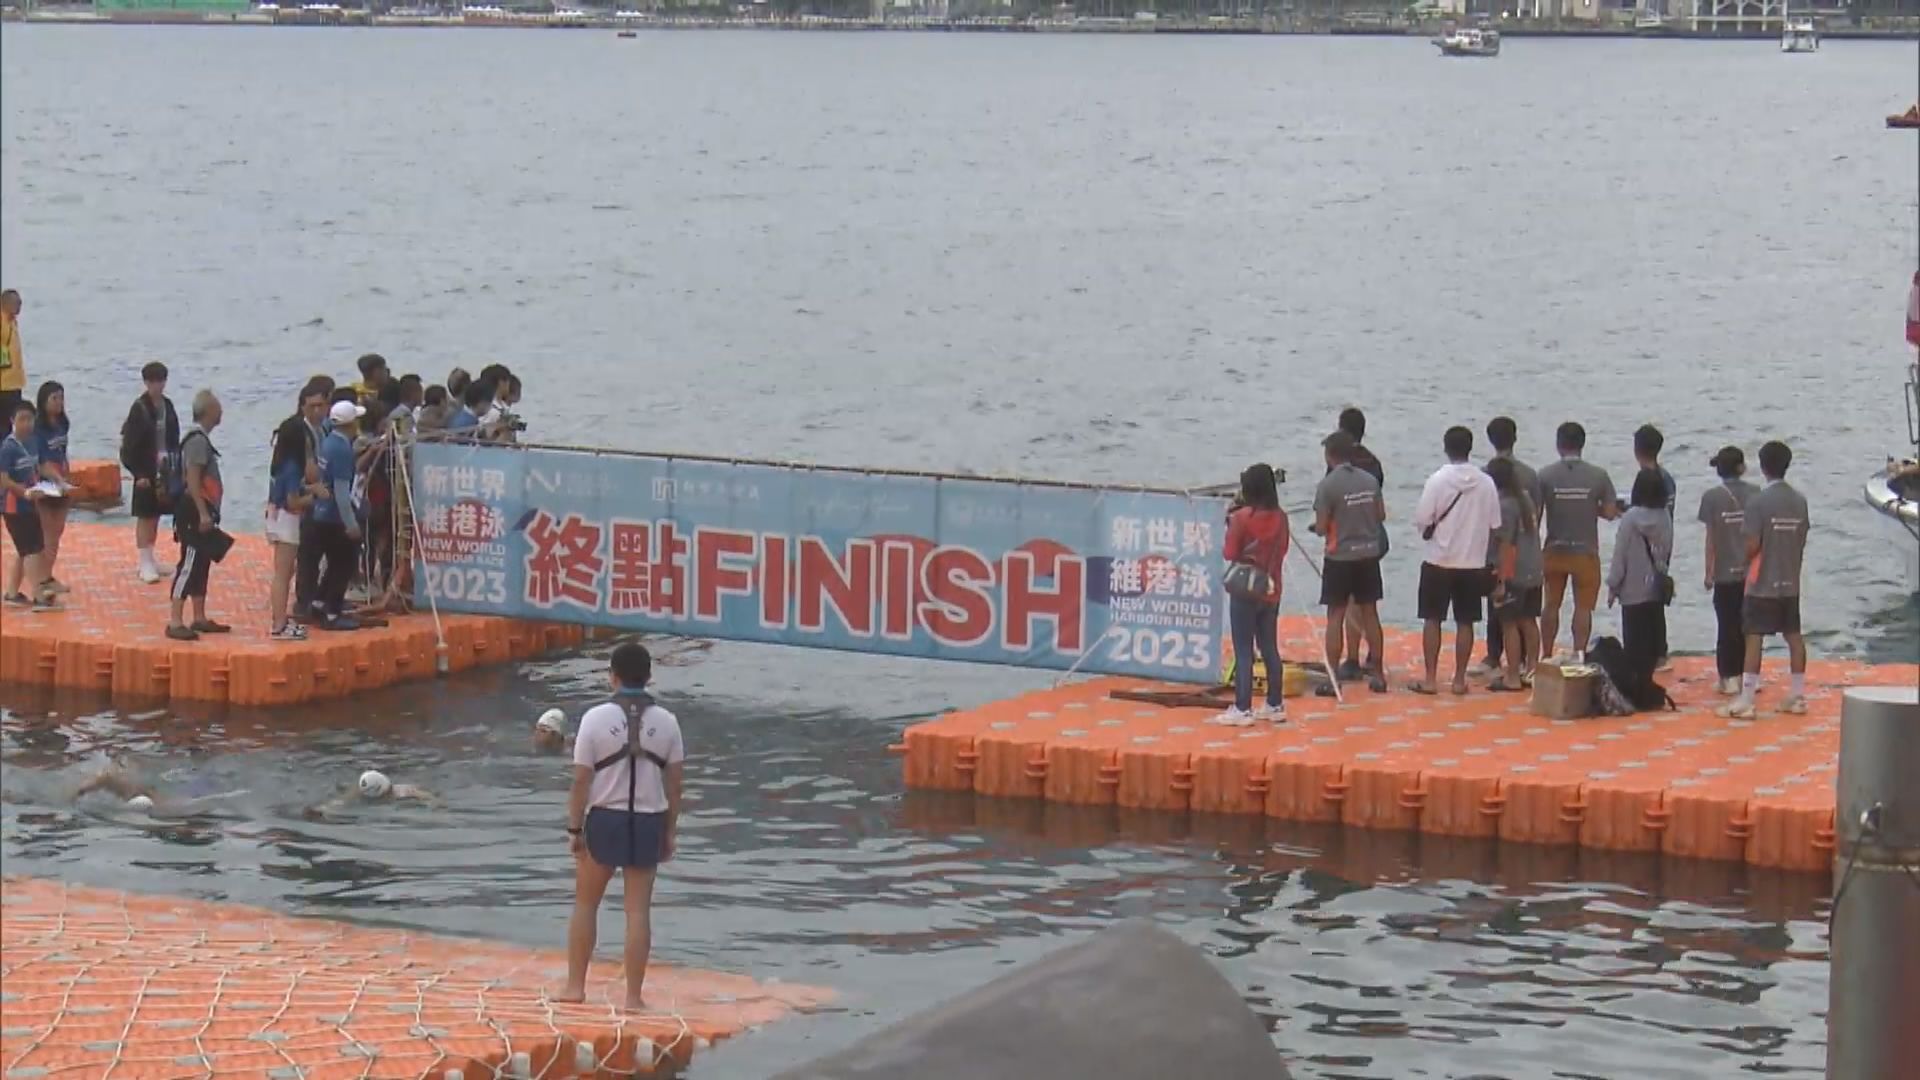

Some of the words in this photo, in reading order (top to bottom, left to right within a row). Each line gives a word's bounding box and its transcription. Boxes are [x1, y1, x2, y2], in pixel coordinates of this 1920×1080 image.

[423, 464, 505, 501] 新世界
[422, 503, 505, 539] 維港泳
[1112, 516, 1211, 556] 新世界
[423, 538, 453, 551] NEW
[457, 540, 505, 555] WORLD
[424, 566, 506, 603] 2023
[693, 525, 1087, 655] FINISH
[1110, 557, 1211, 598] 維港泳
[1110, 597, 1146, 611] NEW
[1152, 601, 1211, 617] WORLD
[1107, 626, 1210, 669] 2023
